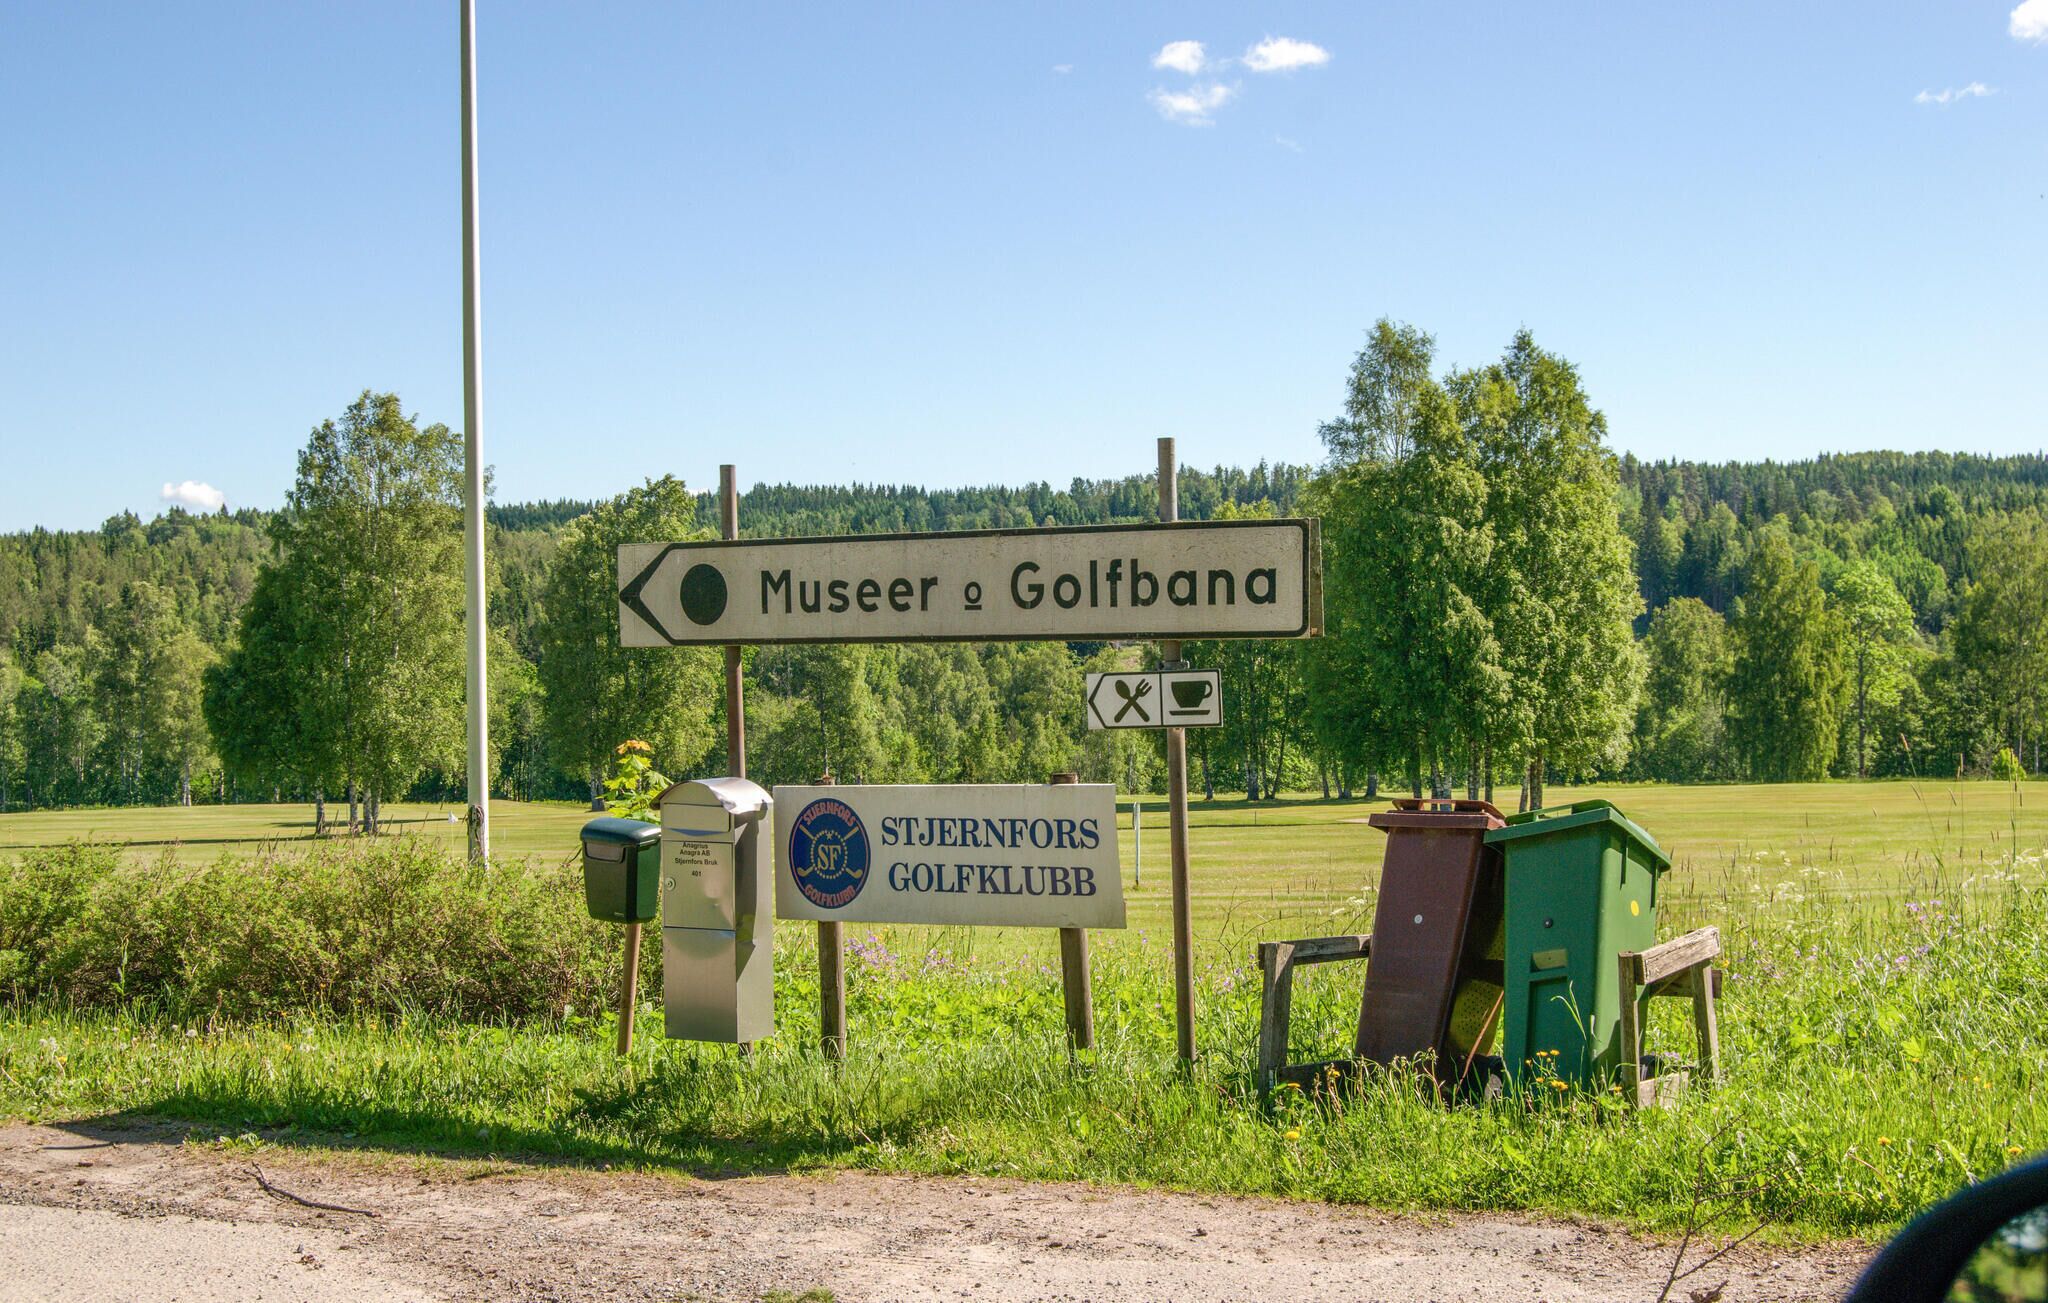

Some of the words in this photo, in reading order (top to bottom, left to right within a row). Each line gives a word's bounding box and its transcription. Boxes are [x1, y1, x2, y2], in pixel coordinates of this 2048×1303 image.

[760, 569, 938, 613] Museer
[1010, 559, 1277, 609] Golfbana
[802, 801, 856, 827] STJERNFORS
[881, 816, 1100, 850] STJERNFORS
[817, 844, 841, 871] SF
[888, 862, 1097, 898] GOLFKLUBB
[804, 884, 856, 907] GOLFKLUBB
